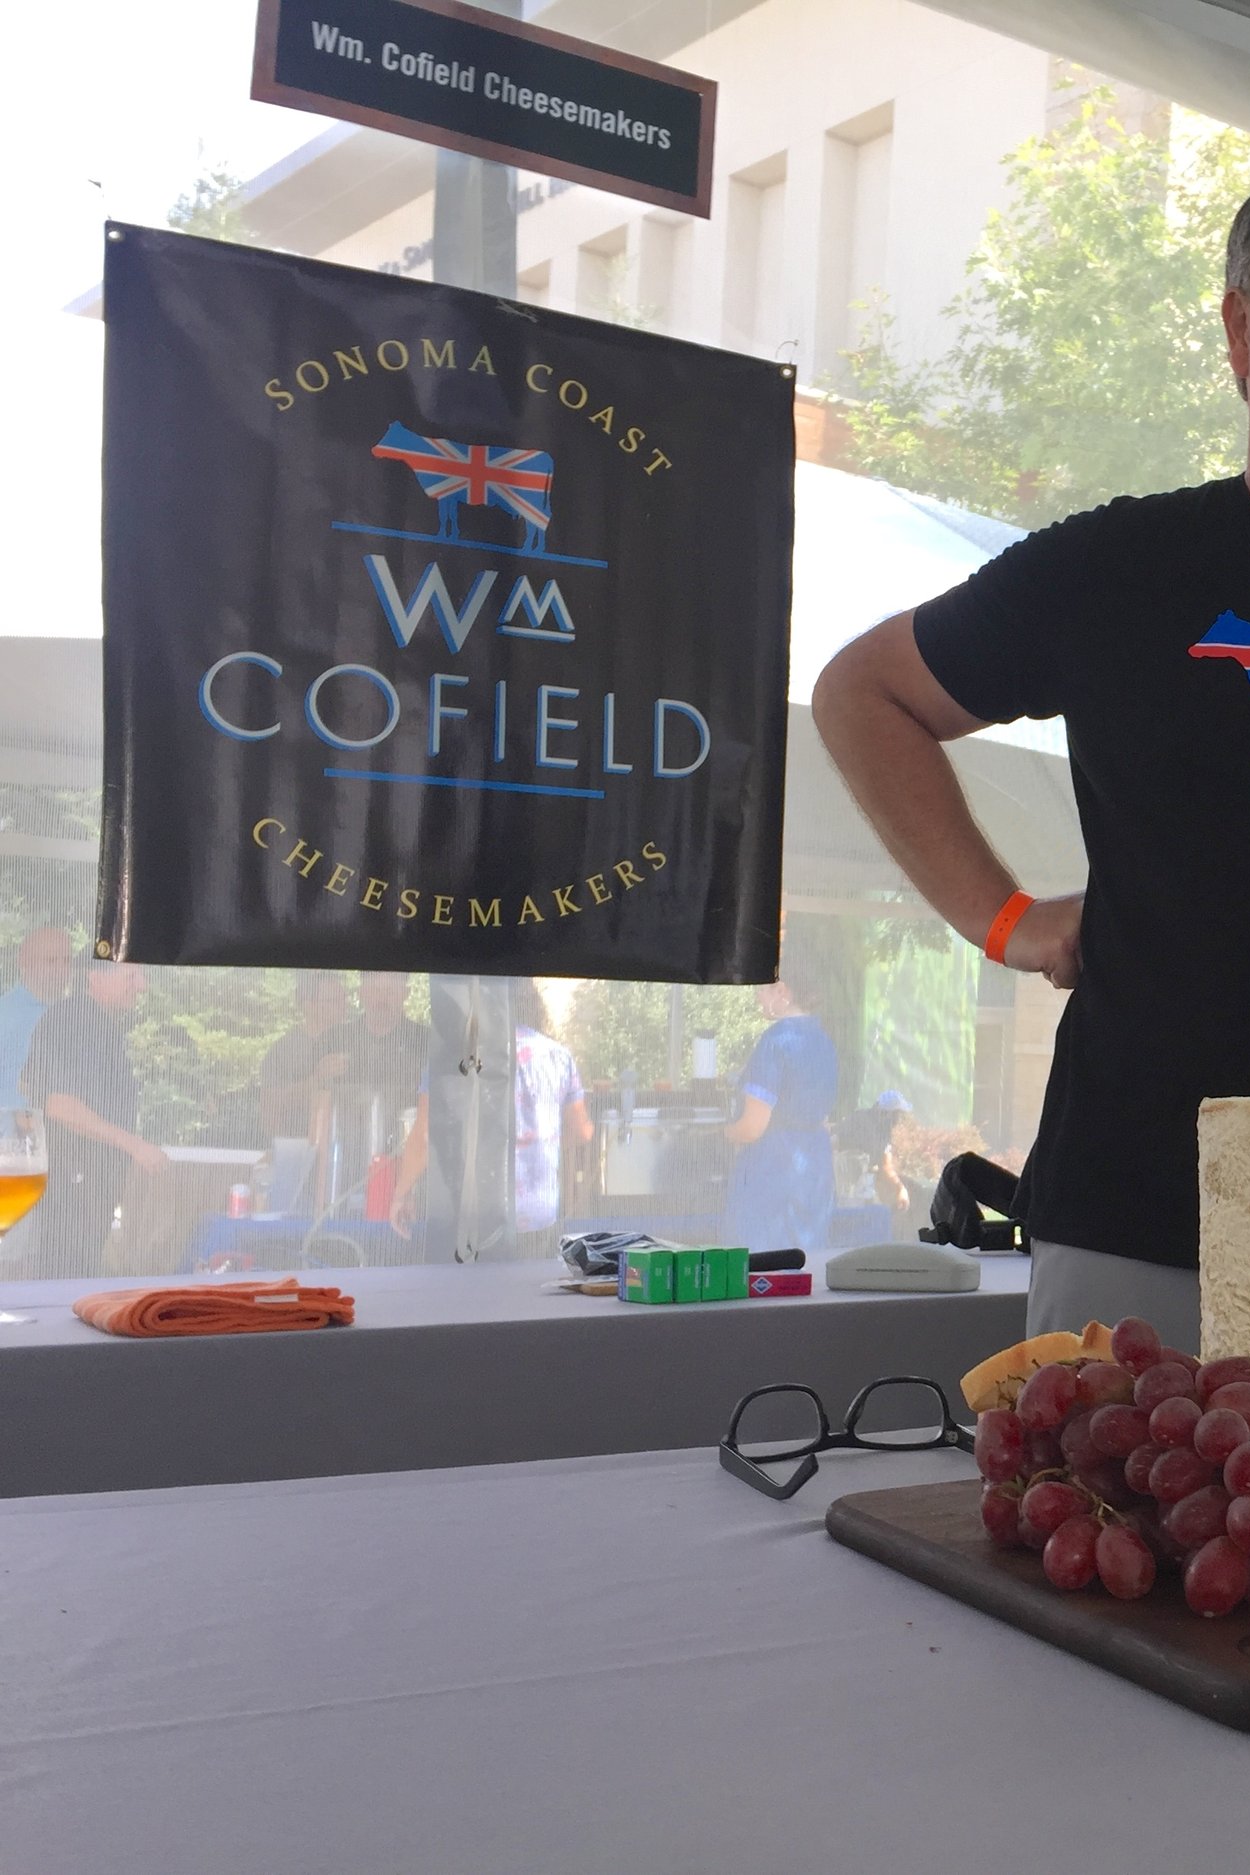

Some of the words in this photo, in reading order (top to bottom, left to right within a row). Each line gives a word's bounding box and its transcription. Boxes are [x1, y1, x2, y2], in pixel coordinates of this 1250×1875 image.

[311, 20, 371, 64] Wm.
[381, 41, 476, 94] Cofield
[484, 71, 672, 150] Cheesemakers
[264, 337, 498, 412] SONOMA
[525, 361, 673, 479] COAST
[199, 650, 712, 778] COFIELD
[252, 817, 668, 928] CHEESEMAKERS
